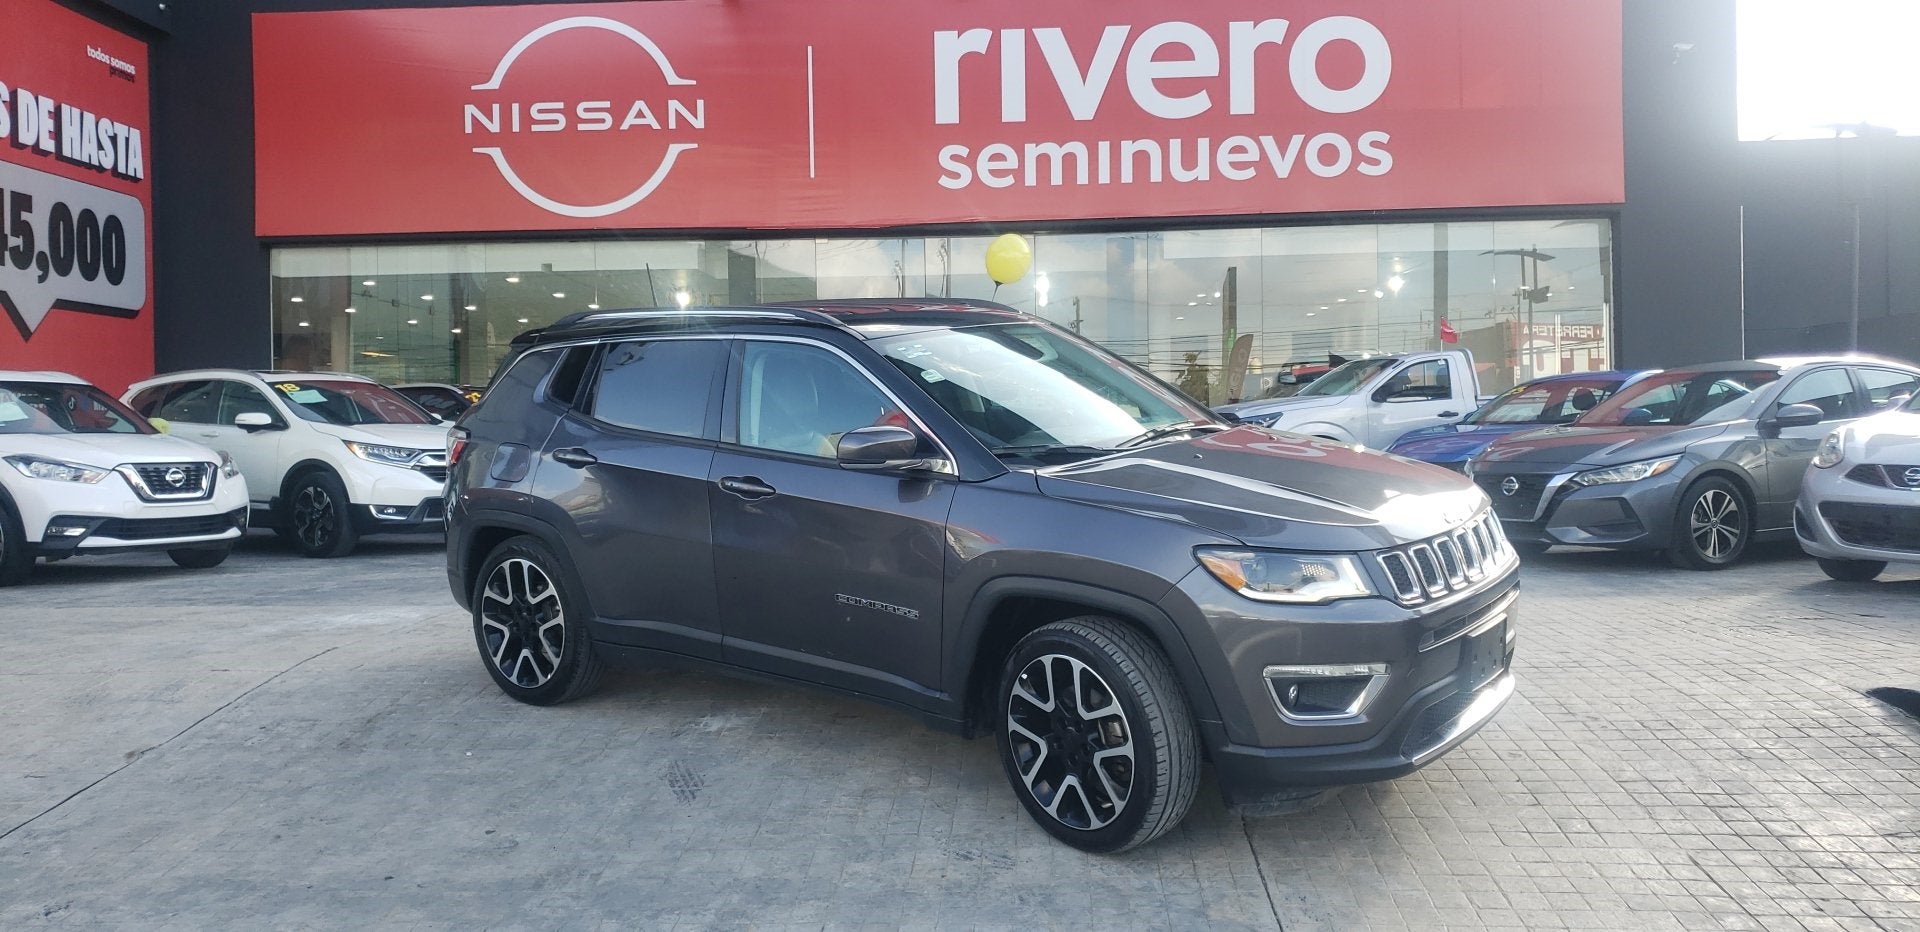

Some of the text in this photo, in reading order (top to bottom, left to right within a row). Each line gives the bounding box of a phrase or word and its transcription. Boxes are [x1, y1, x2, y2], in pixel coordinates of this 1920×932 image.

[87, 44, 136, 75] todos somos
[933, 15, 1392, 125] rivero
[17, 87, 56, 153] DE
[61, 103, 144, 179] HASTA
[464, 99, 705, 134] NISSAN
[937, 131, 1393, 190] seminuevos
[834, 593, 919, 620] COMPASS
